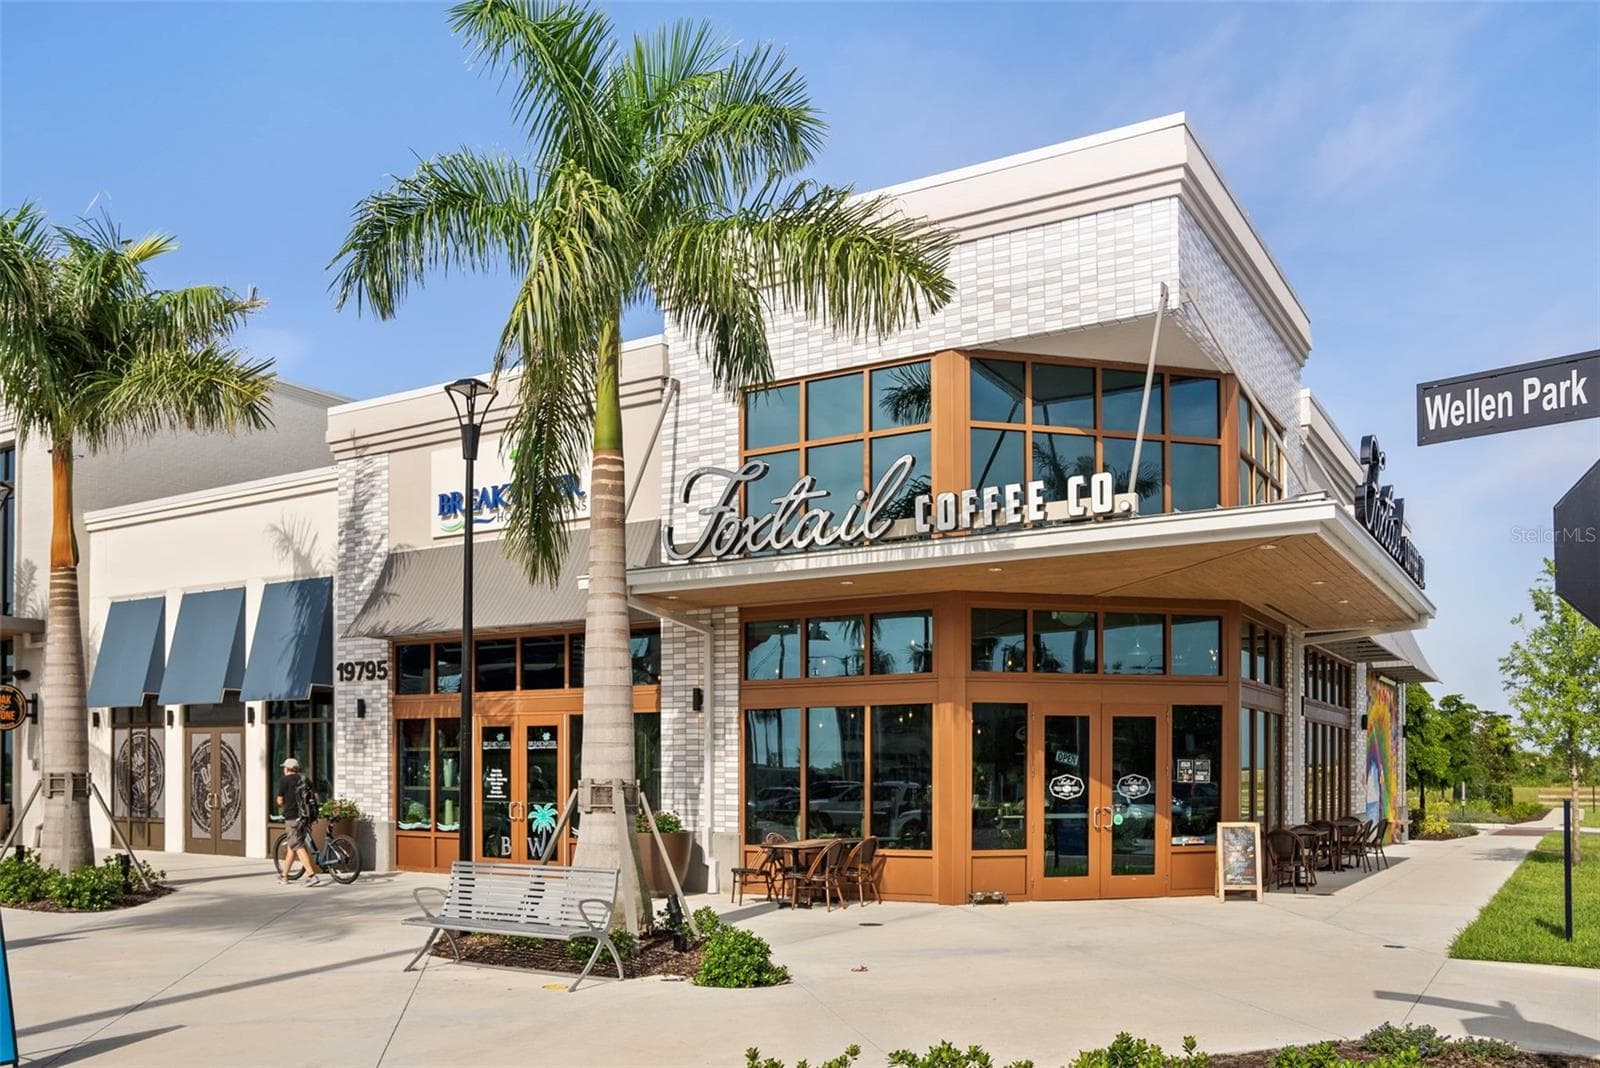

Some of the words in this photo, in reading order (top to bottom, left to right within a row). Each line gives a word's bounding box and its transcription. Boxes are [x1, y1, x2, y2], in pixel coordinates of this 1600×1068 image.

[1425, 387, 1513, 430] Wellen
[1523, 369, 1588, 414] Park
[663, 454, 917, 560] Foxtail
[915, 480, 1047, 533] COFFEE
[1067, 472, 1133, 517] CO.
[336, 660, 388, 682] 19795
[1056, 752, 1078, 766] OPEN
[501, 836, 512, 856] B
